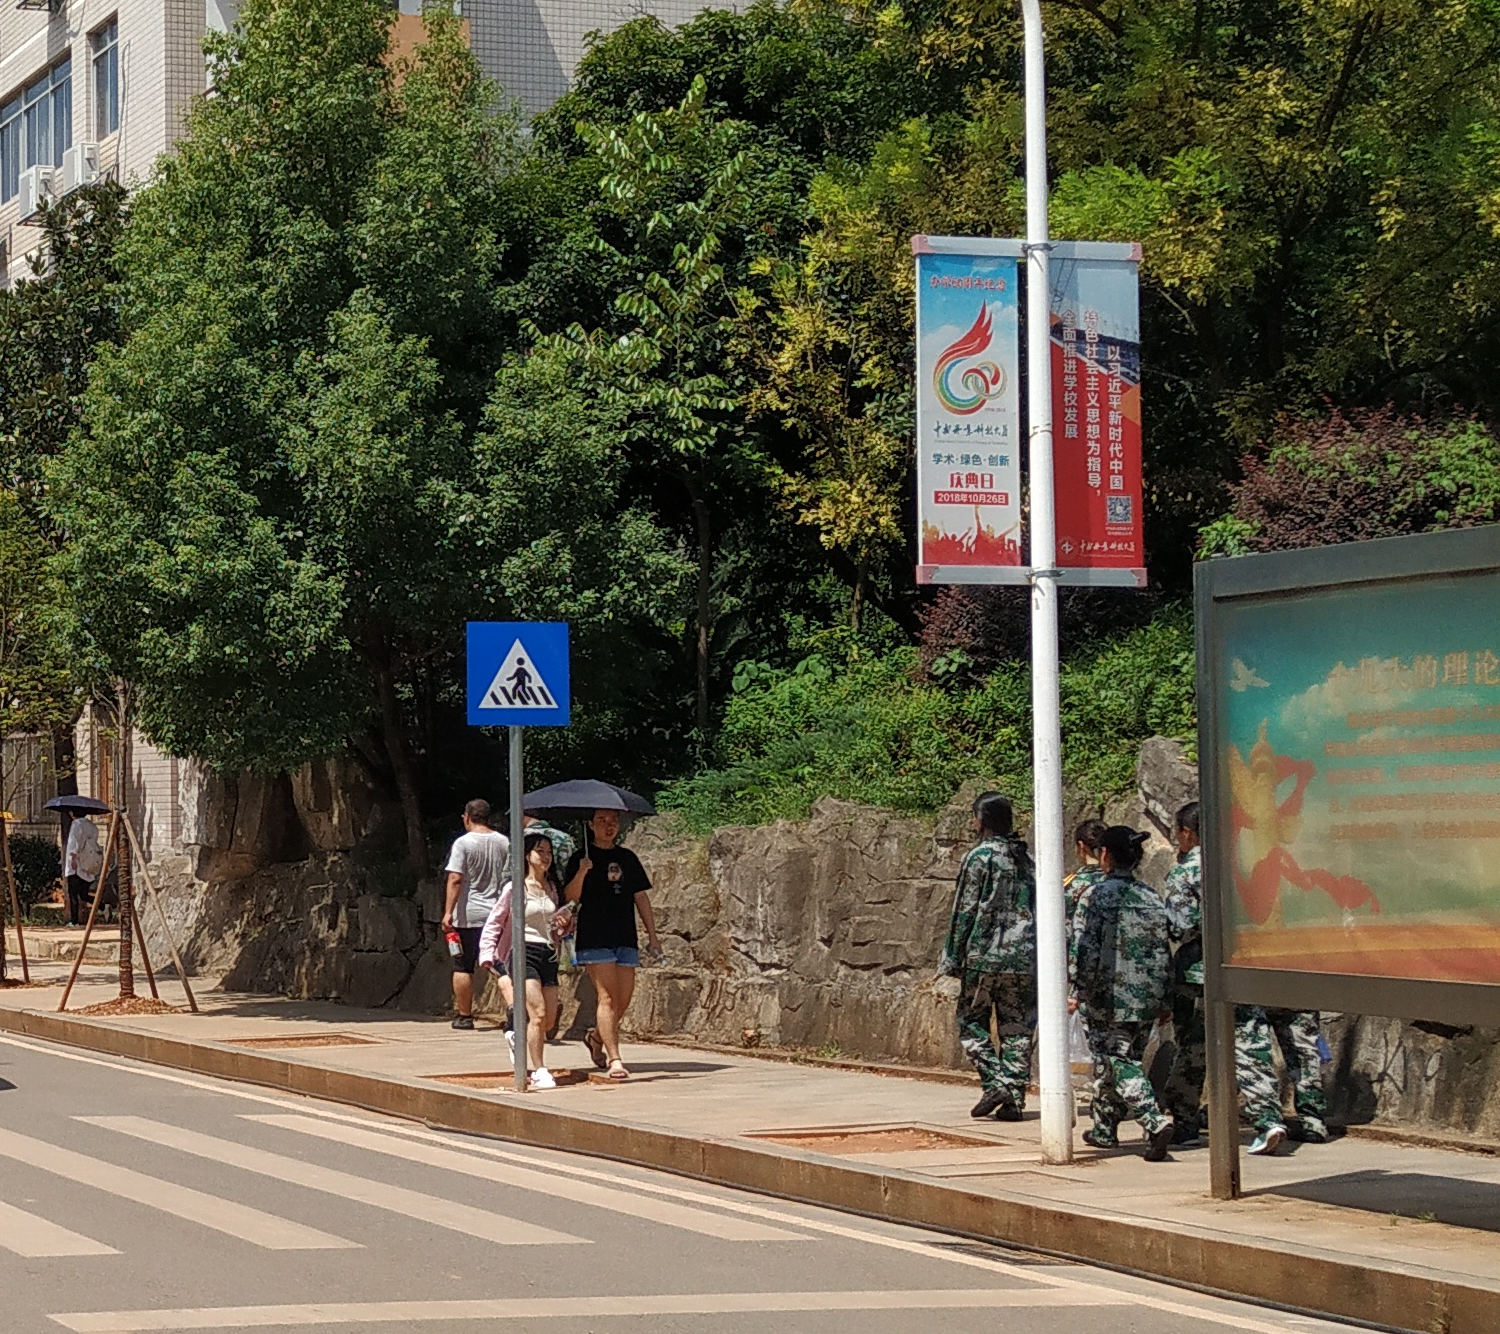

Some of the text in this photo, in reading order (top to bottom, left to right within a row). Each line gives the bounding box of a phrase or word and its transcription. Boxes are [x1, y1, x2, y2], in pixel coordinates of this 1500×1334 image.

[1062, 310, 1079, 439] 全面推进学校发展
[1107, 346, 1124, 491] 以习近平新时代中国
[937, 492, 1006, 504] 2018年10月26日
[950, 472, 994, 489] 庆典日
